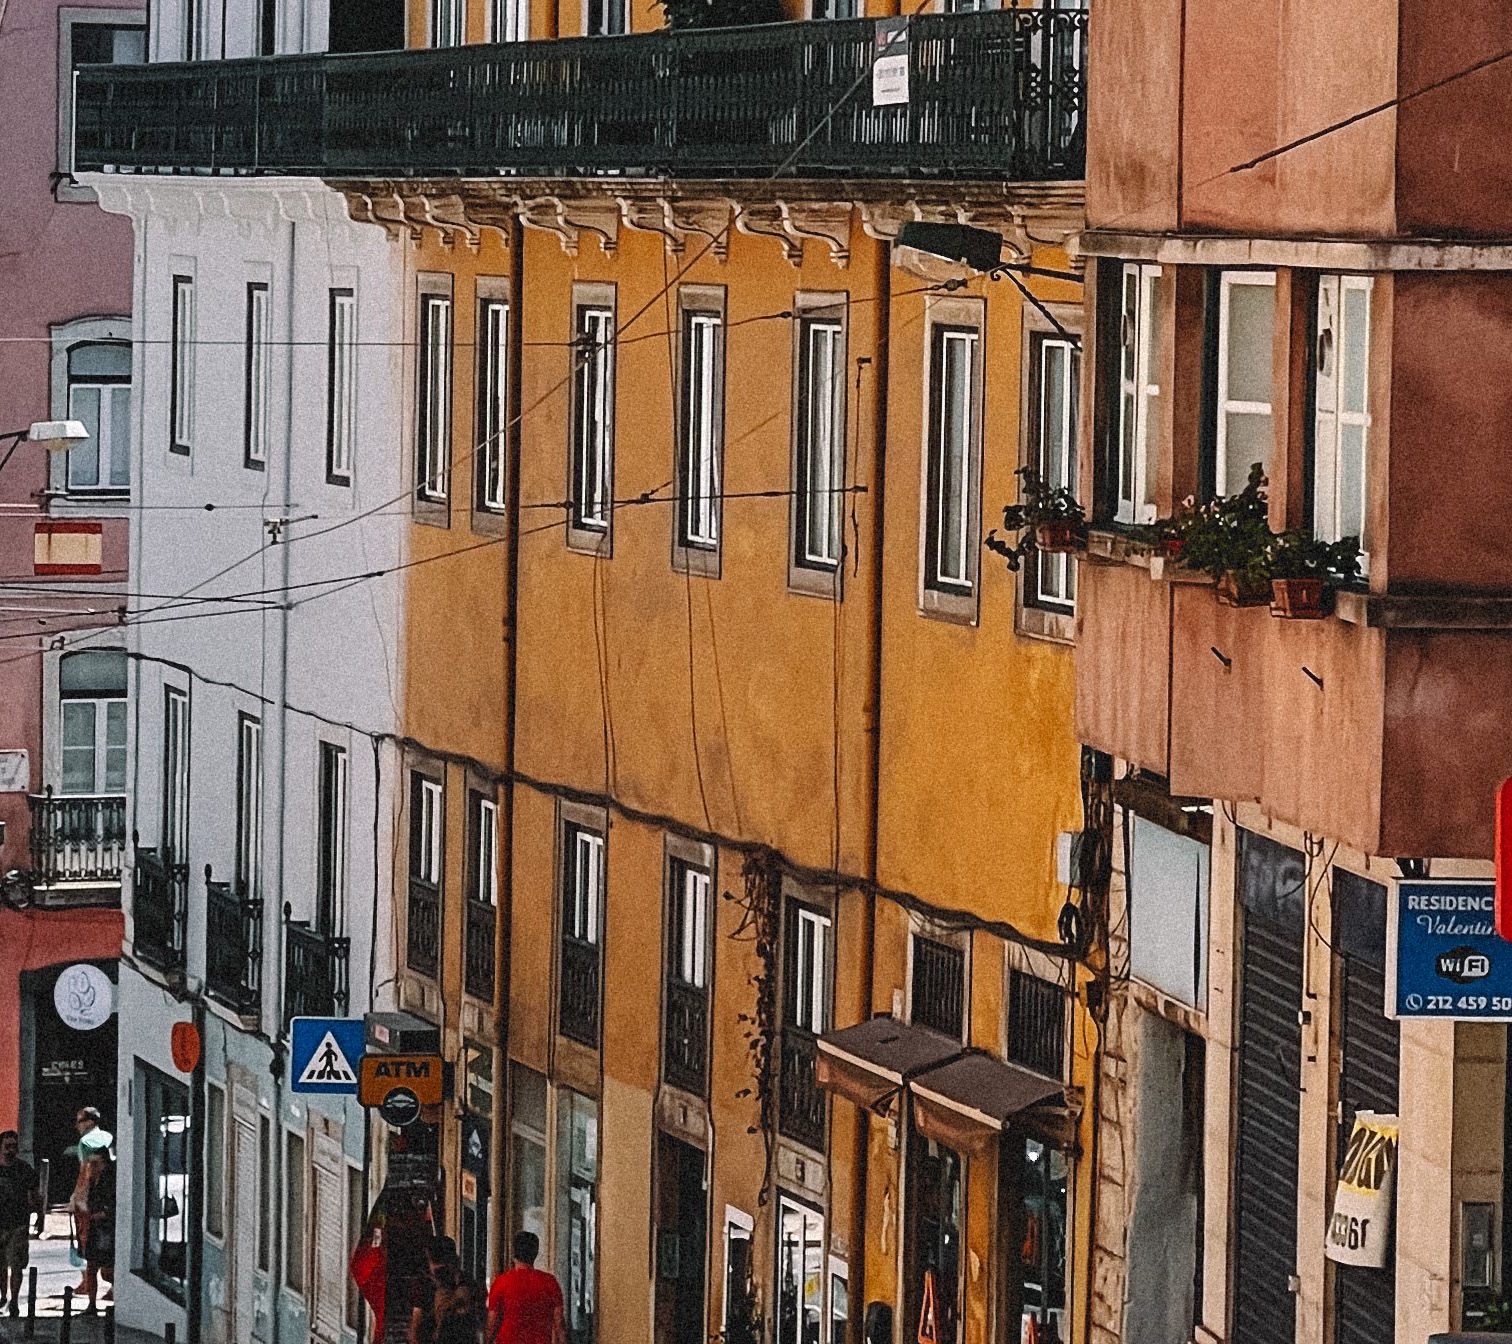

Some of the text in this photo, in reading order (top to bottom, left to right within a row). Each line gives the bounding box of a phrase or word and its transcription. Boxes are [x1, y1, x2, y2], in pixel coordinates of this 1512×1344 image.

[1427, 995, 1512, 1011] 212 459 50
[375, 1061, 430, 1077] ATM
